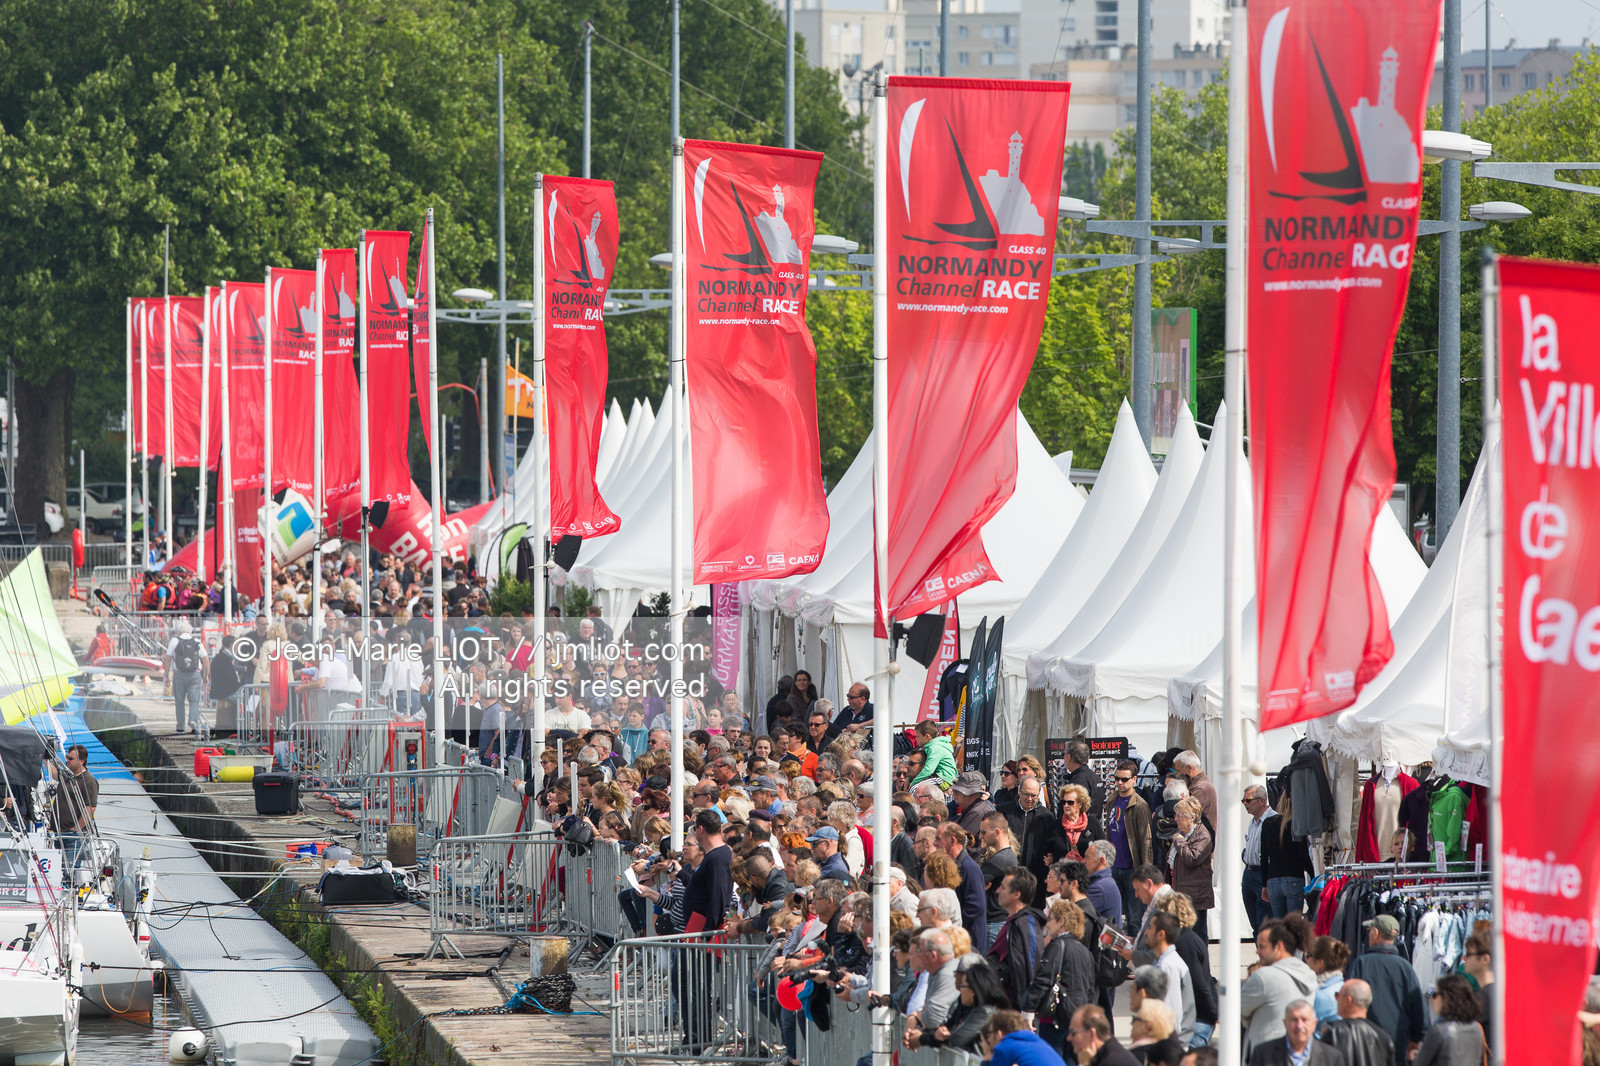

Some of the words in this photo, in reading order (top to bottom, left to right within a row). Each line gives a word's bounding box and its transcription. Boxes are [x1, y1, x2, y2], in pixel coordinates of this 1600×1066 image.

[1009, 245, 1034, 254] CLASS
[1036, 247, 1046, 255] 40
[1351, 243, 1410, 269] RAC
[898, 255, 1044, 278] NORMANDY
[698, 280, 802, 297] NORMANDY
[897, 277, 980, 297] Channel
[982, 280, 1041, 300] RACE
[552, 292, 601, 306] NORMAN
[698, 297, 758, 312] Channel
[762, 298, 799, 315] RACE
[897, 303, 1008, 315] www.normandy-race.com
[1519, 294, 1561, 371] la
[274, 340, 315, 350] NORMAND
[299, 350, 316, 360] RAC
[1091, 740, 1122, 750] isotoner
[12, 887, 26, 896] 82
